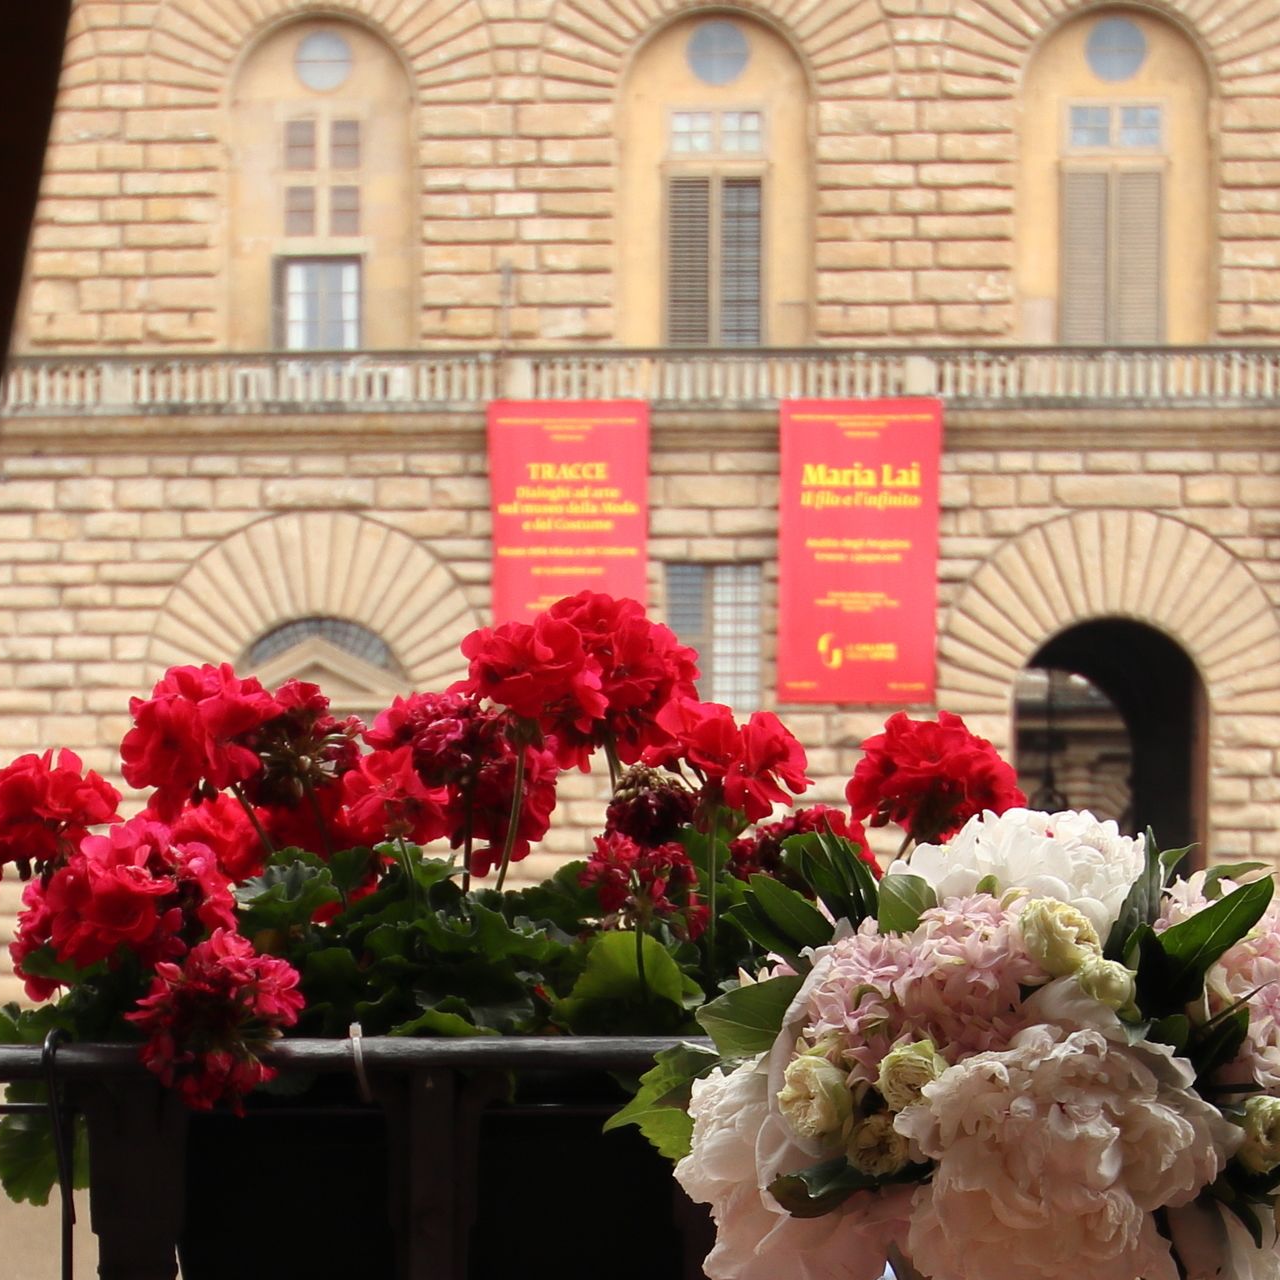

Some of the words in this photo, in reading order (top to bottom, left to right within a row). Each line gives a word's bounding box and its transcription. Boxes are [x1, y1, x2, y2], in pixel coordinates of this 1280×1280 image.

[526, 462, 608, 481] TRACCE
[801, 462, 876, 488] Maria
[881, 461, 920, 488] Lai
[814, 491, 840, 510] filo
[841, 495, 852, 506] e
